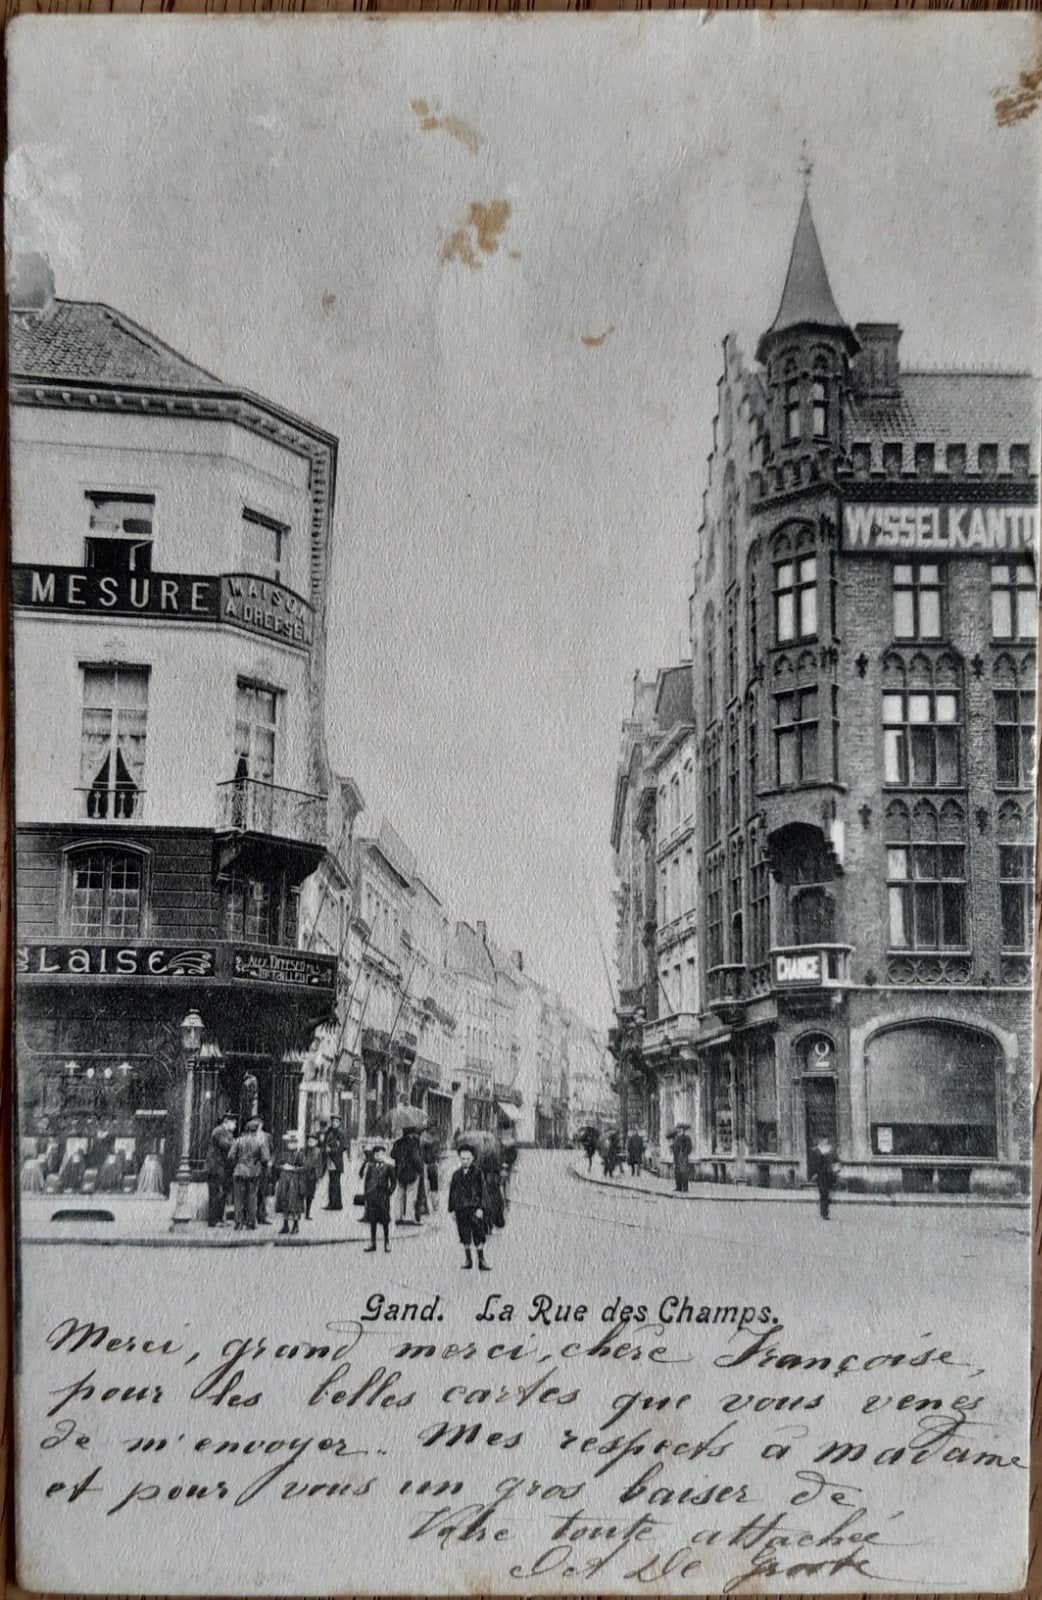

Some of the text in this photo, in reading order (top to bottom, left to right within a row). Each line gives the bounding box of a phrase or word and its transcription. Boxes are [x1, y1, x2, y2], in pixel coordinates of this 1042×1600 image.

[31, 571, 211, 612] MESURE
[814, 1041, 831, 1067] 2
[46, 1317, 985, 1399] Merci, grand merci, chère Françoise,
[47, 1369, 163, 1416] pour
[207, 1369, 263, 1407] les
[308, 1362, 417, 1408] belles
[442, 1367, 581, 1407] cartes
[600, 1391, 692, 1431] que
[718, 1394, 825, 1414] vous
[40, 1419, 91, 1450] de
[418, 1421, 534, 1449] Mes
[560, 1420, 737, 1478] respects
[761, 1425, 809, 1461] à
[813, 1416, 1028, 1468] madame
[45, 1462, 862, 1522] et pour vous un gros baiser de
[409, 1503, 513, 1550] Votre
[549, 1508, 660, 1541] toute
